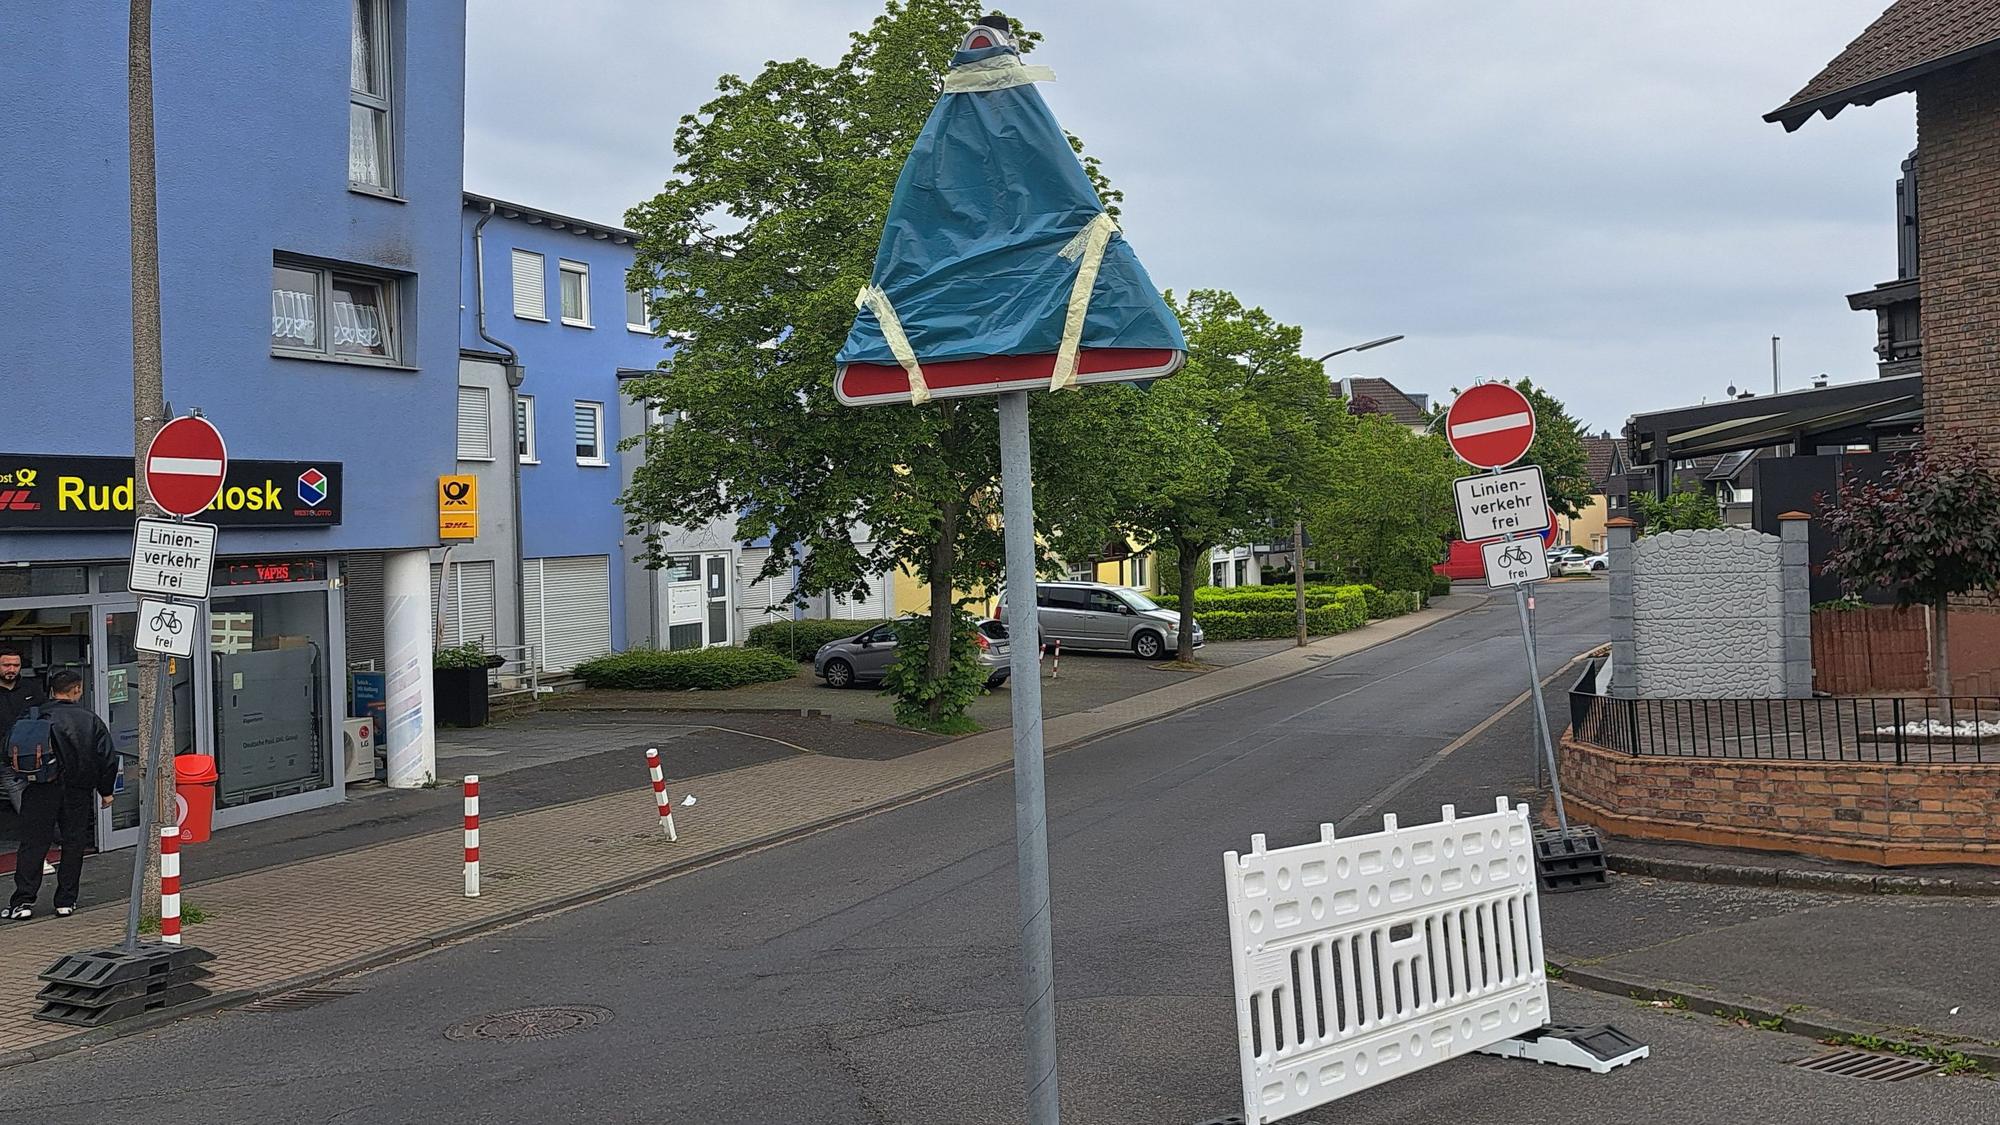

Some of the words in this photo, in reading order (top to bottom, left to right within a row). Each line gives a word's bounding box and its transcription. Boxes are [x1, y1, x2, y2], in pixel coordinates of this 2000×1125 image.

[58, 476, 134, 511] Rud
[207, 479, 283, 511] iosk
[1471, 481, 1526, 498] Linien-
[1471, 496, 1532, 515] verkehr
[1491, 513, 1519, 530] frei
[149, 528, 200, 548] Linien-
[144, 551, 201, 569] verkehr
[157, 570, 183, 588] frei
[257, 566, 289, 580] VAPES
[1508, 568, 1528, 580] frei
[154, 635, 174, 648] frei
[360, 740, 369, 748] LG
